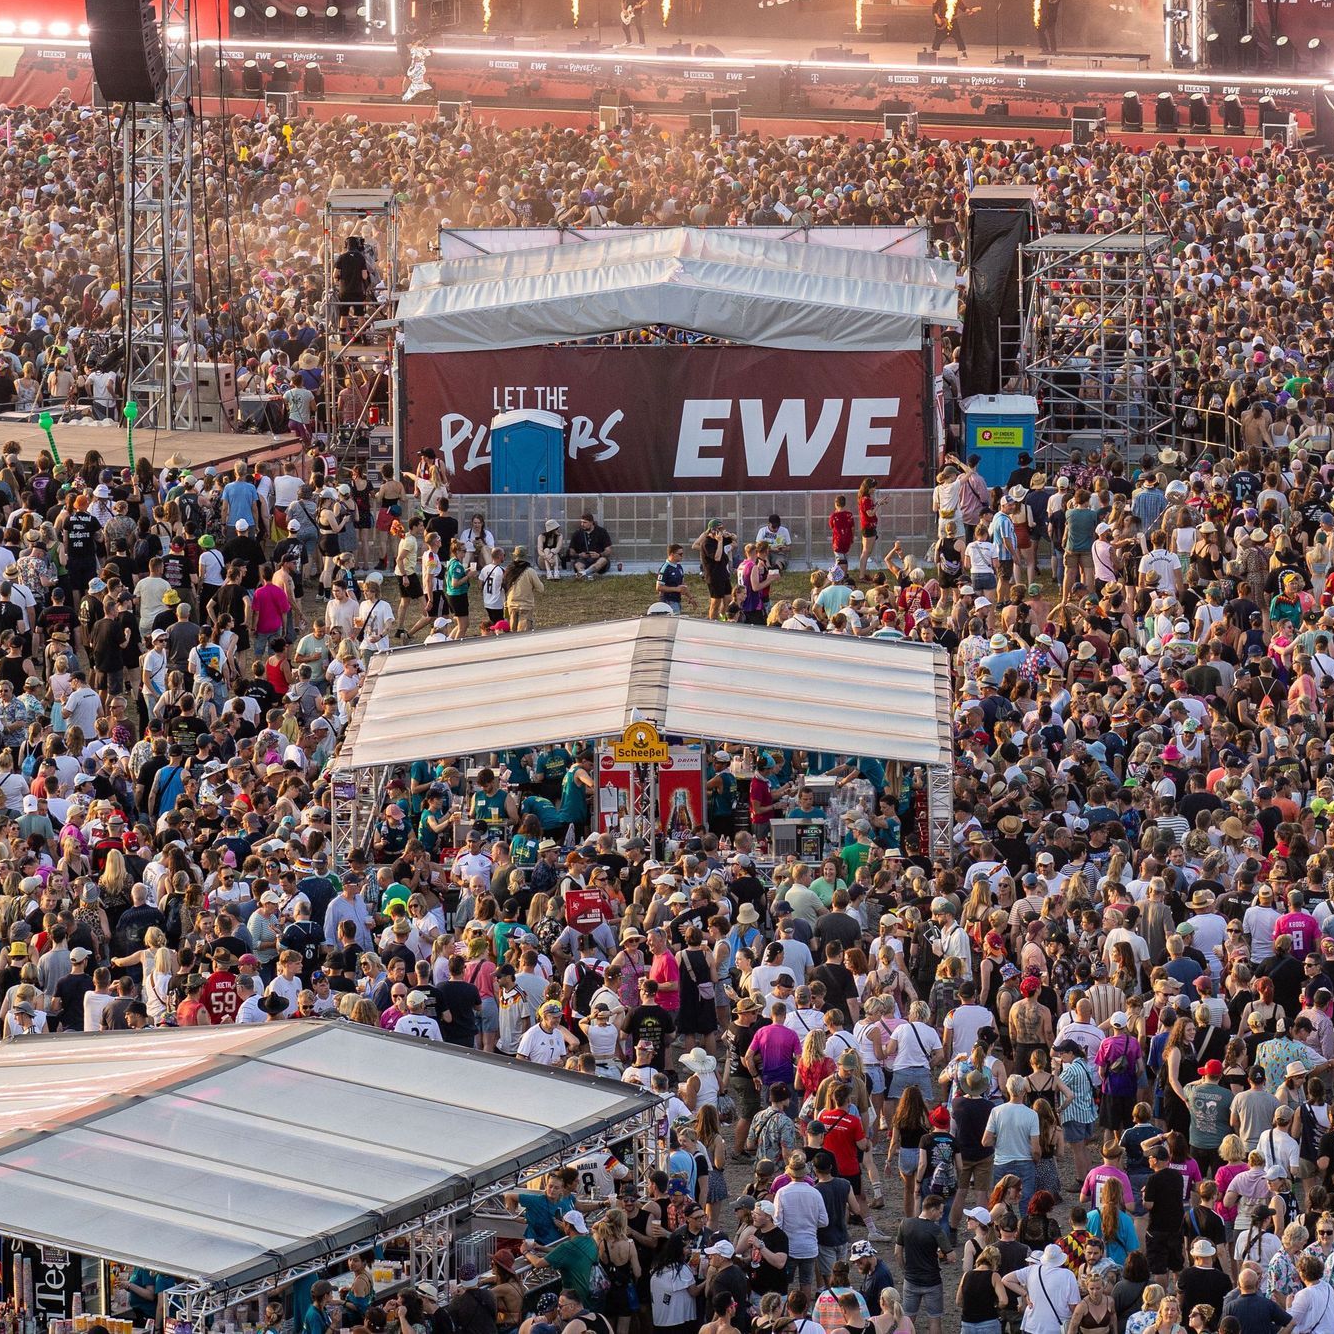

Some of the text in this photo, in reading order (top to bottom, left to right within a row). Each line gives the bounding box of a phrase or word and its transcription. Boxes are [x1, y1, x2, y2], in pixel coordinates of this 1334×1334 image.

[931, 76, 948, 84] EWE
[1223, 86, 1240, 94] EWE
[1264, 87, 1292, 96] PLAYERS
[493, 386, 568, 410] LET THE
[440, 408, 624, 475] PLRS
[673, 397, 900, 477] EWE
[618, 748, 665, 759] Scheeßel
[1292, 930, 1303, 951] 8
[210, 991, 237, 1014] 59
[550, 1047, 555, 1058] 7
[576, 1172, 589, 1194] 8
